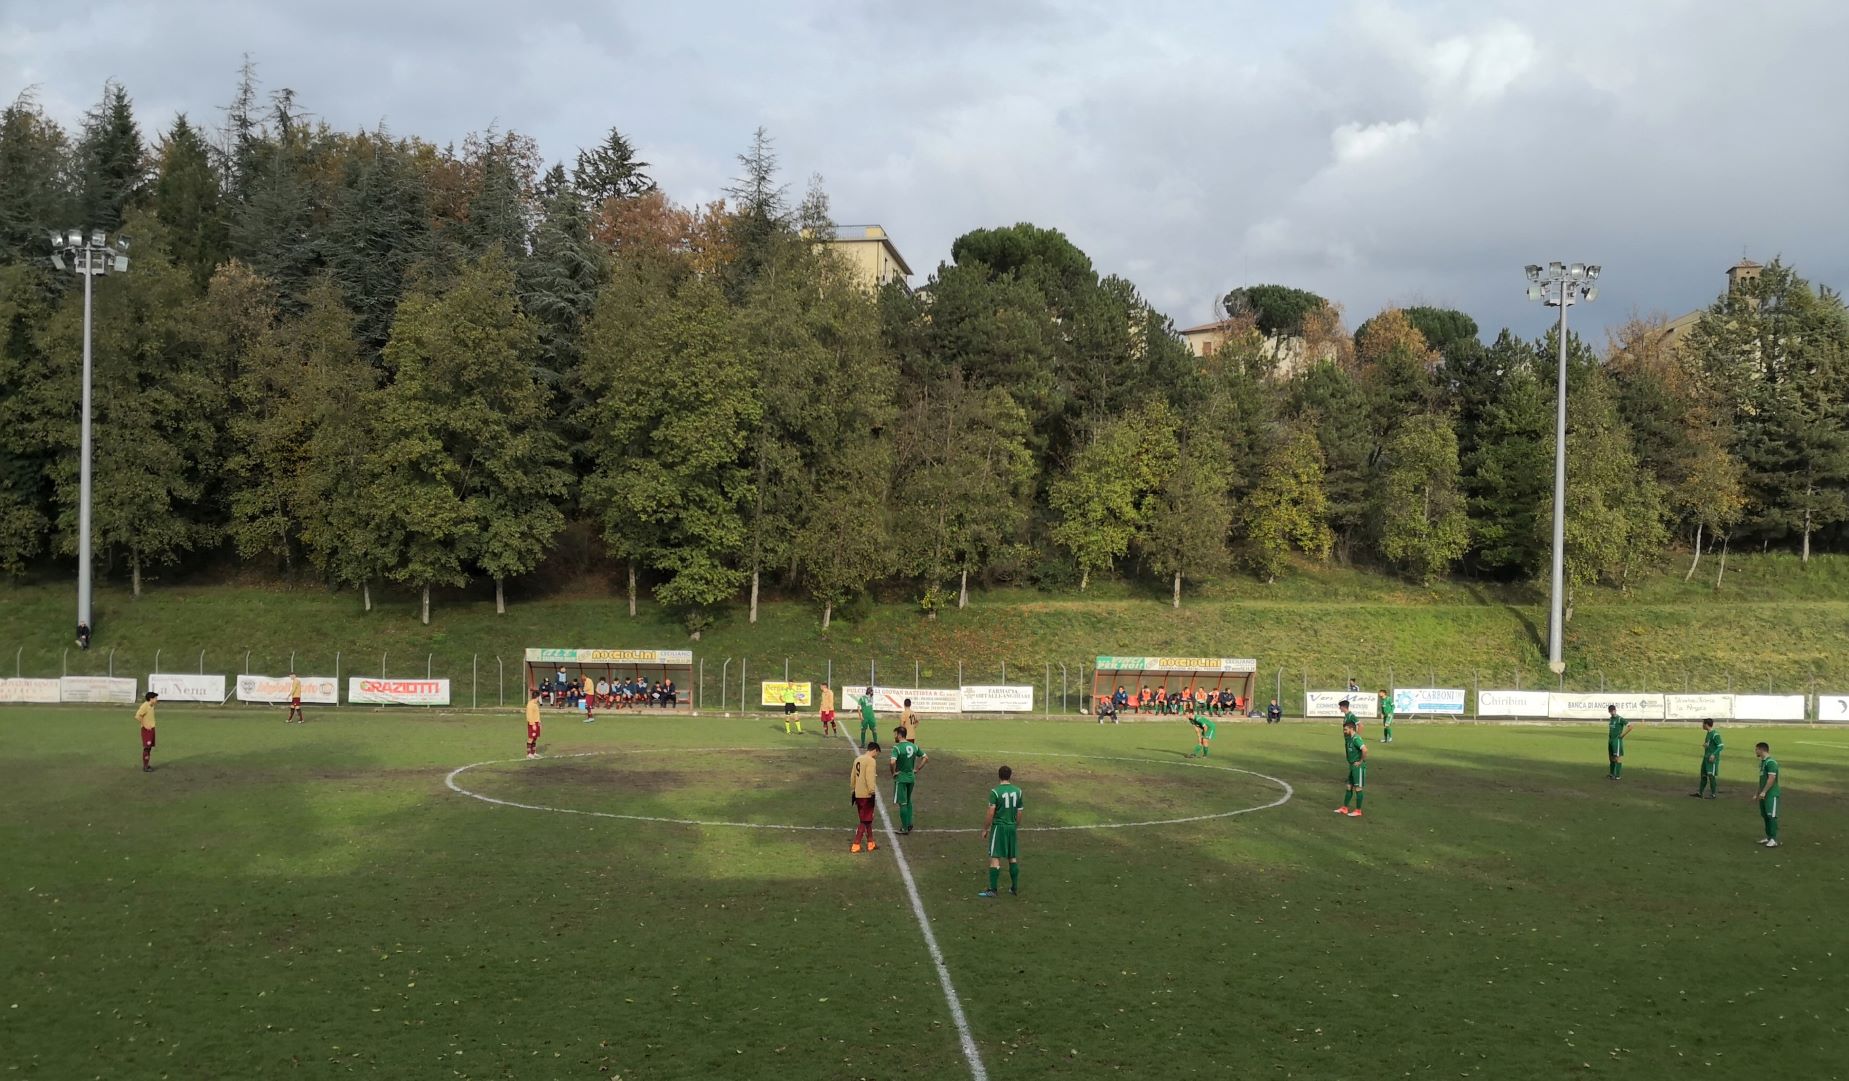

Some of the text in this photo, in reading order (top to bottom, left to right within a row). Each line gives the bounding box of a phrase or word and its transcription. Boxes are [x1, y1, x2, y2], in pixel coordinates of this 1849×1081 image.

[360, 680, 440, 694] GRAZIOTTI
[1422, 690, 1454, 700] CARBONI
[905, 745, 914, 758] 9
[855, 761, 861, 777] 9
[1001, 791, 1018, 809] 11
